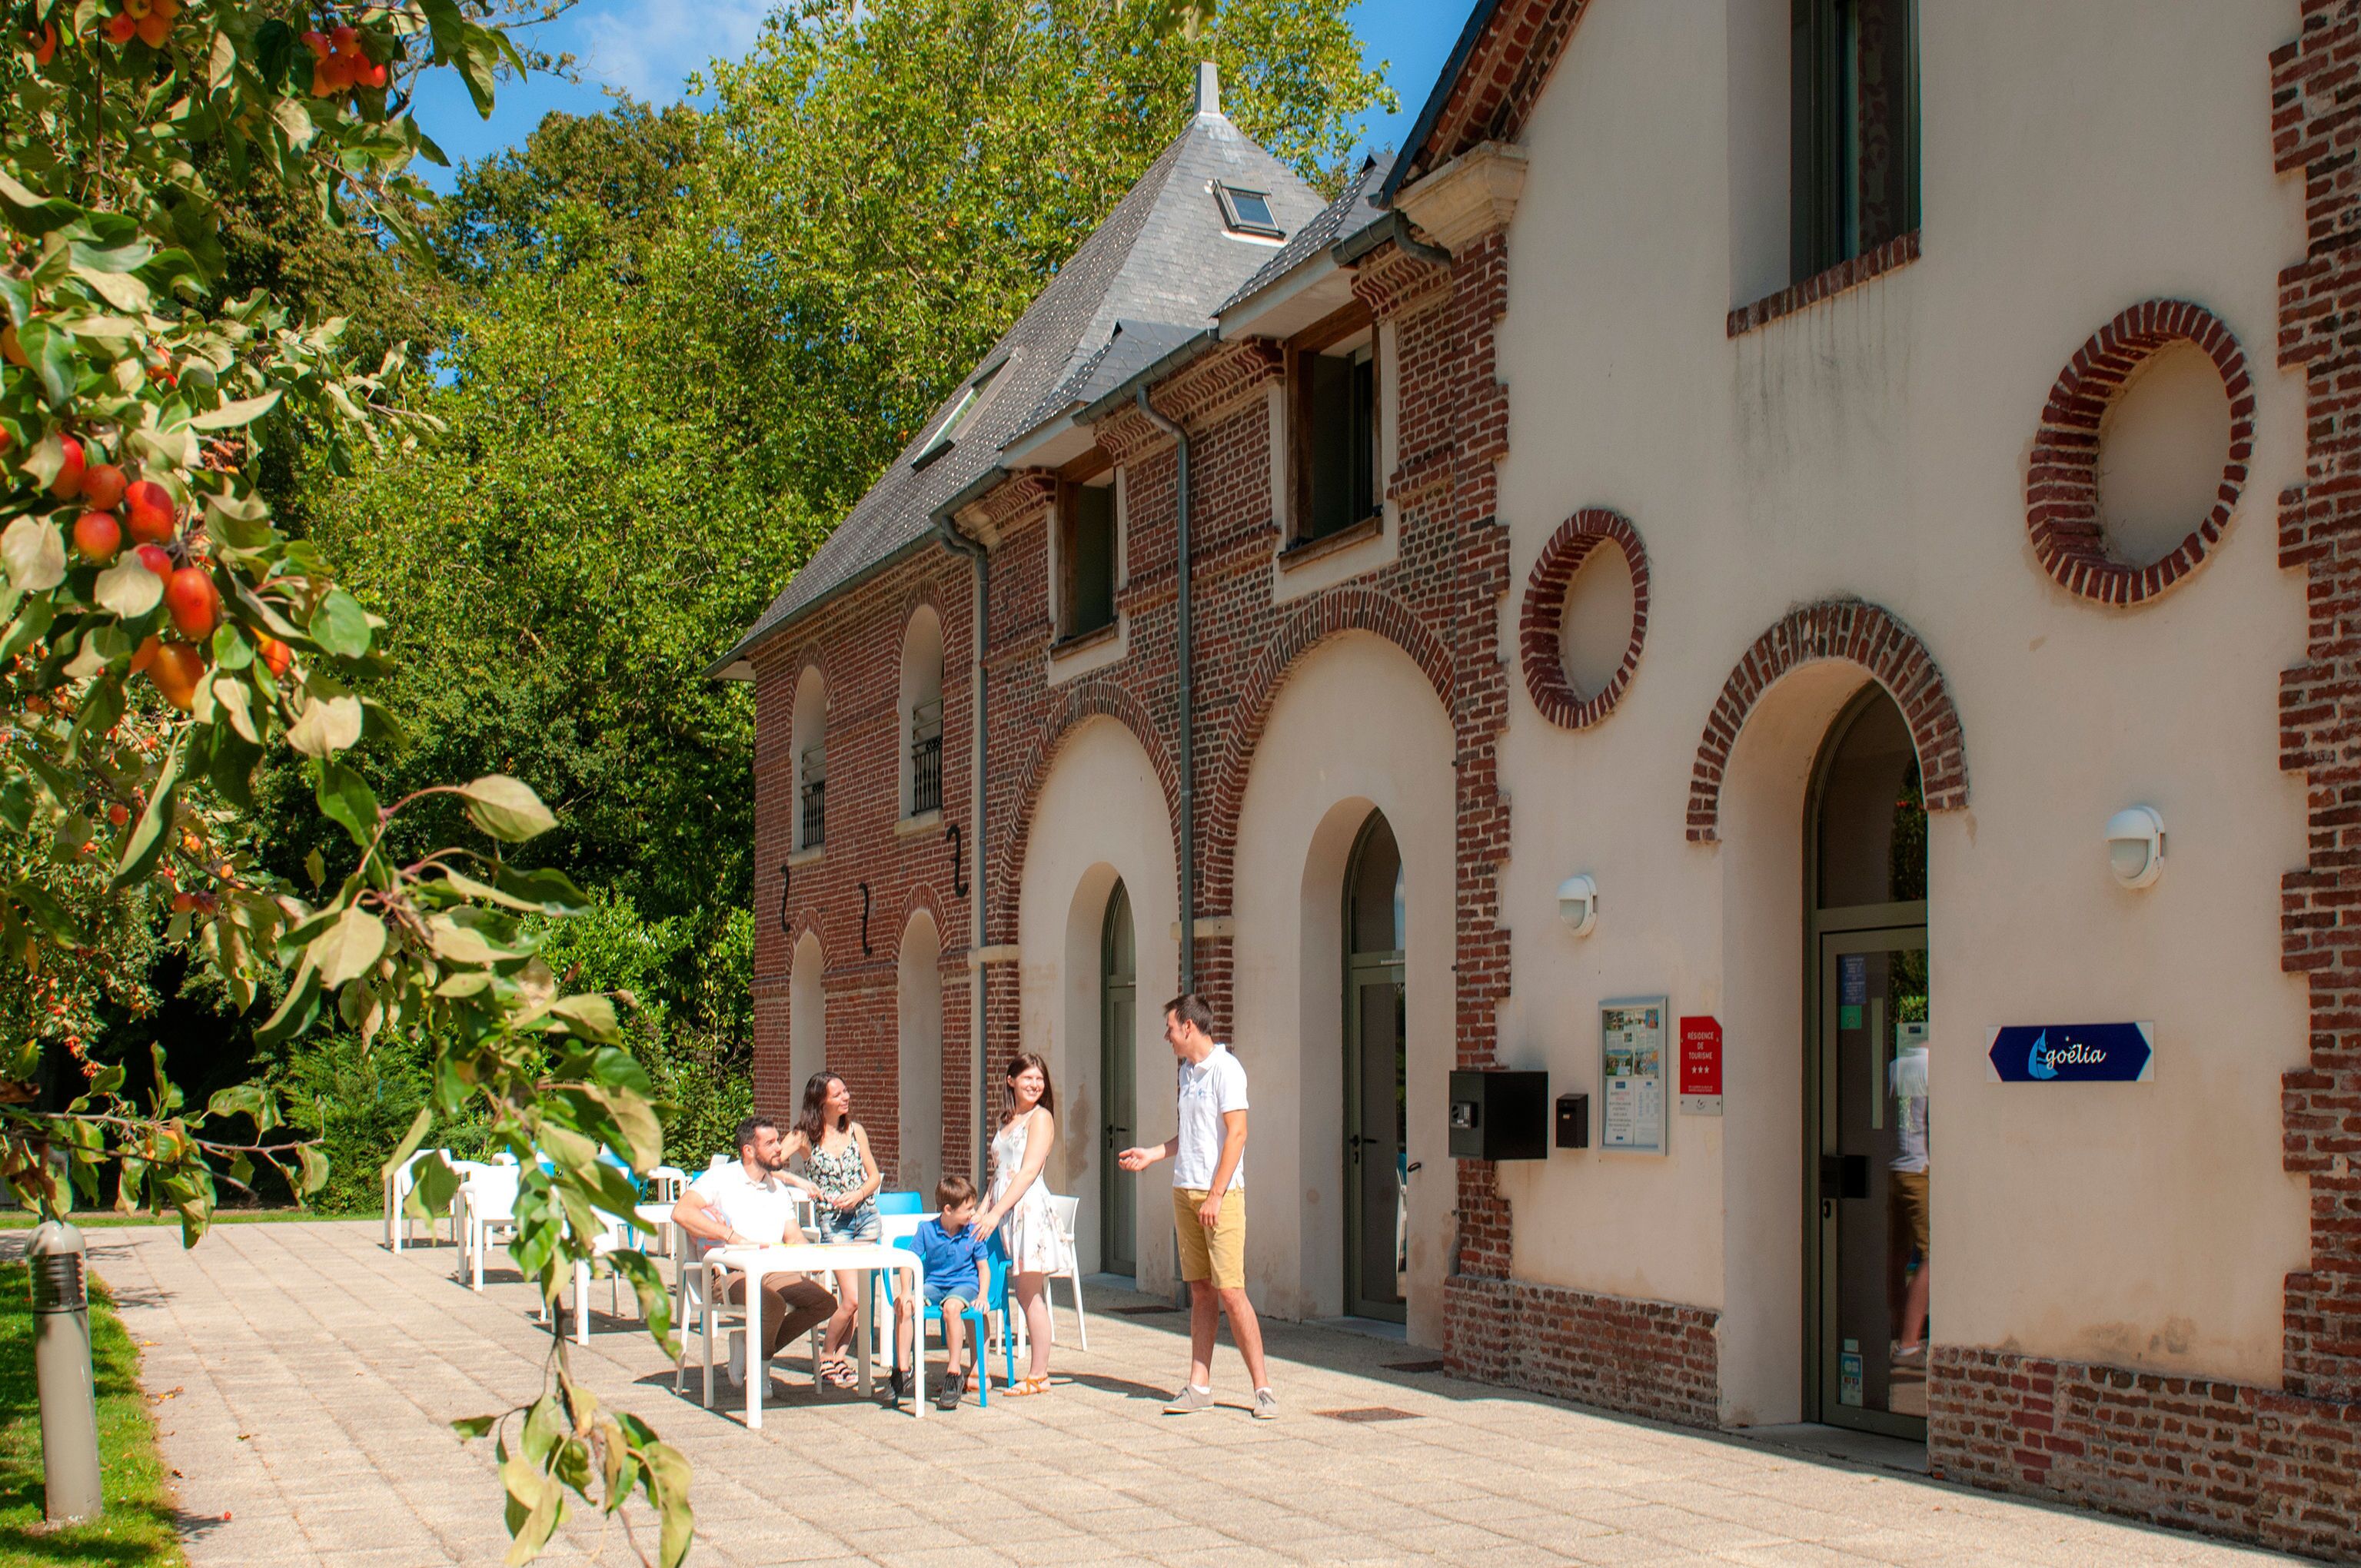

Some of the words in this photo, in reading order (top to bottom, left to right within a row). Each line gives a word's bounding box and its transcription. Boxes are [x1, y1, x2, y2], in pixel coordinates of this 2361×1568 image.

[1688, 1031, 1714, 1040] RÉSIDENCE
[1697, 1041, 1704, 1050] DE
[1688, 1051, 1713, 1060] TOURISME
